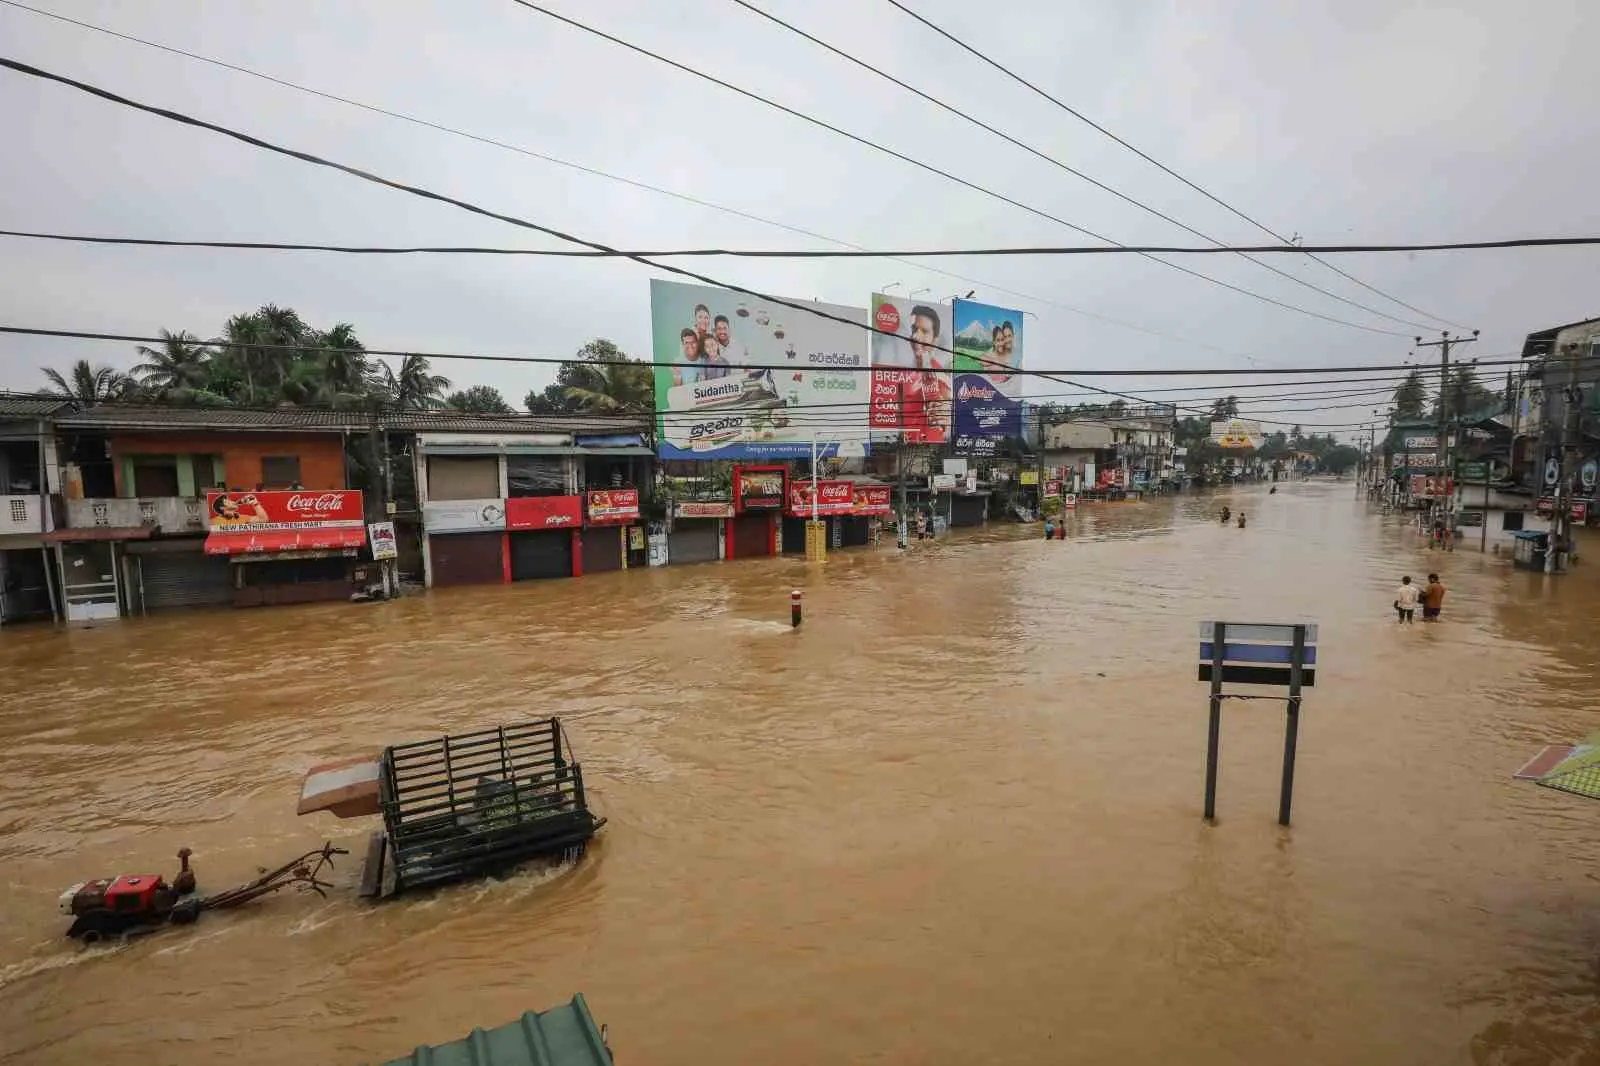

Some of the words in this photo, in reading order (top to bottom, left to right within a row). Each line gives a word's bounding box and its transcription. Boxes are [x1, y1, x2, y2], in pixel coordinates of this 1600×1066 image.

[874, 370, 913, 384] BREAK
[693, 383, 740, 400] Sudantha
[286, 493, 345, 512] Coca-Cola
